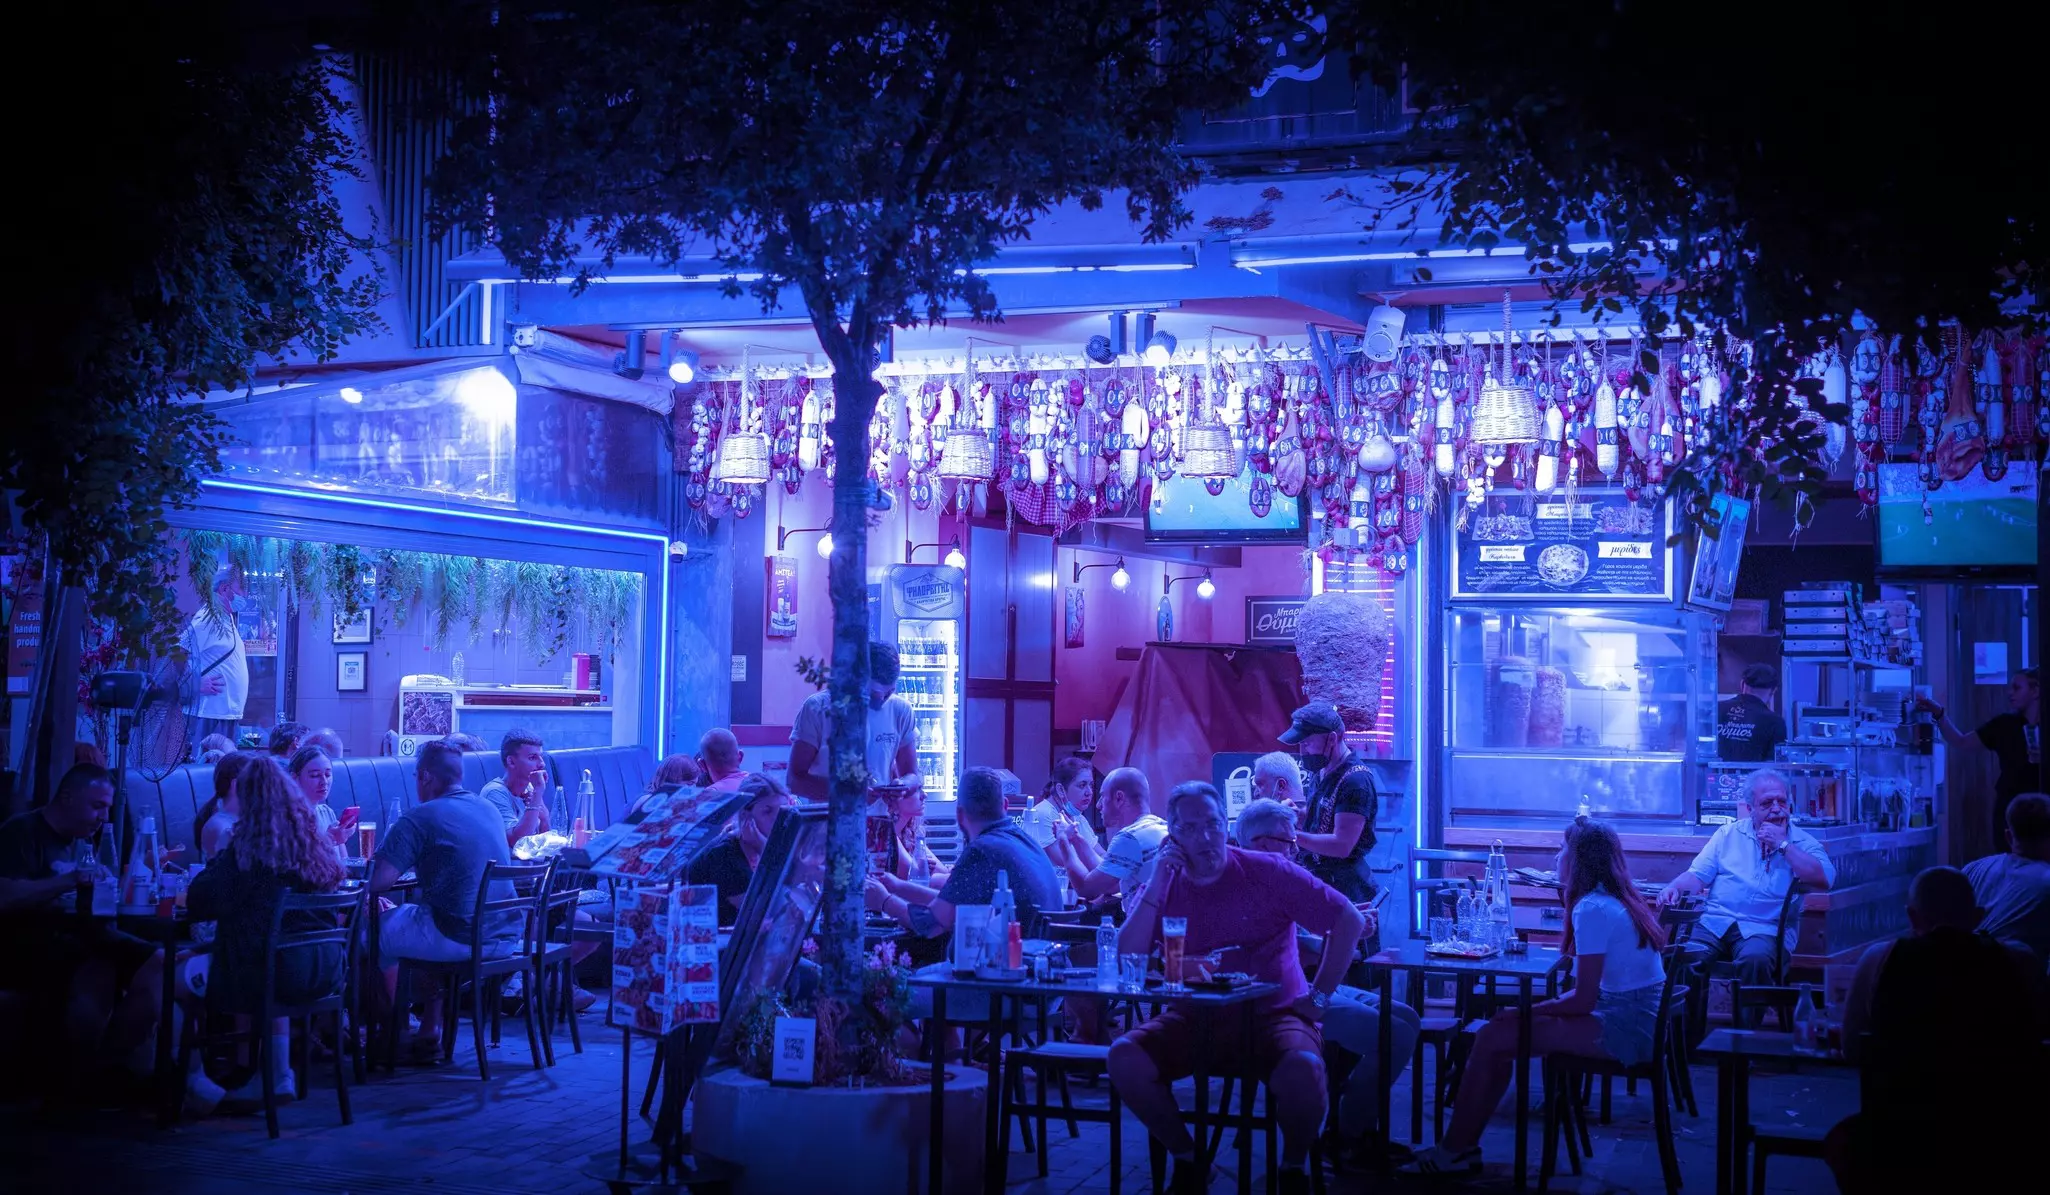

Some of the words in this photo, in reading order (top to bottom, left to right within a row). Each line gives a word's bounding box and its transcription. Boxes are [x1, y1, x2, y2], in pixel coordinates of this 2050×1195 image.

[20, 611, 41, 621] Fresh
[1274, 607, 1302, 619] Μπαρ
[14, 624, 41, 634] handm
[1256, 613, 1298, 635] Θύμι
[16, 637, 40, 648] produ
